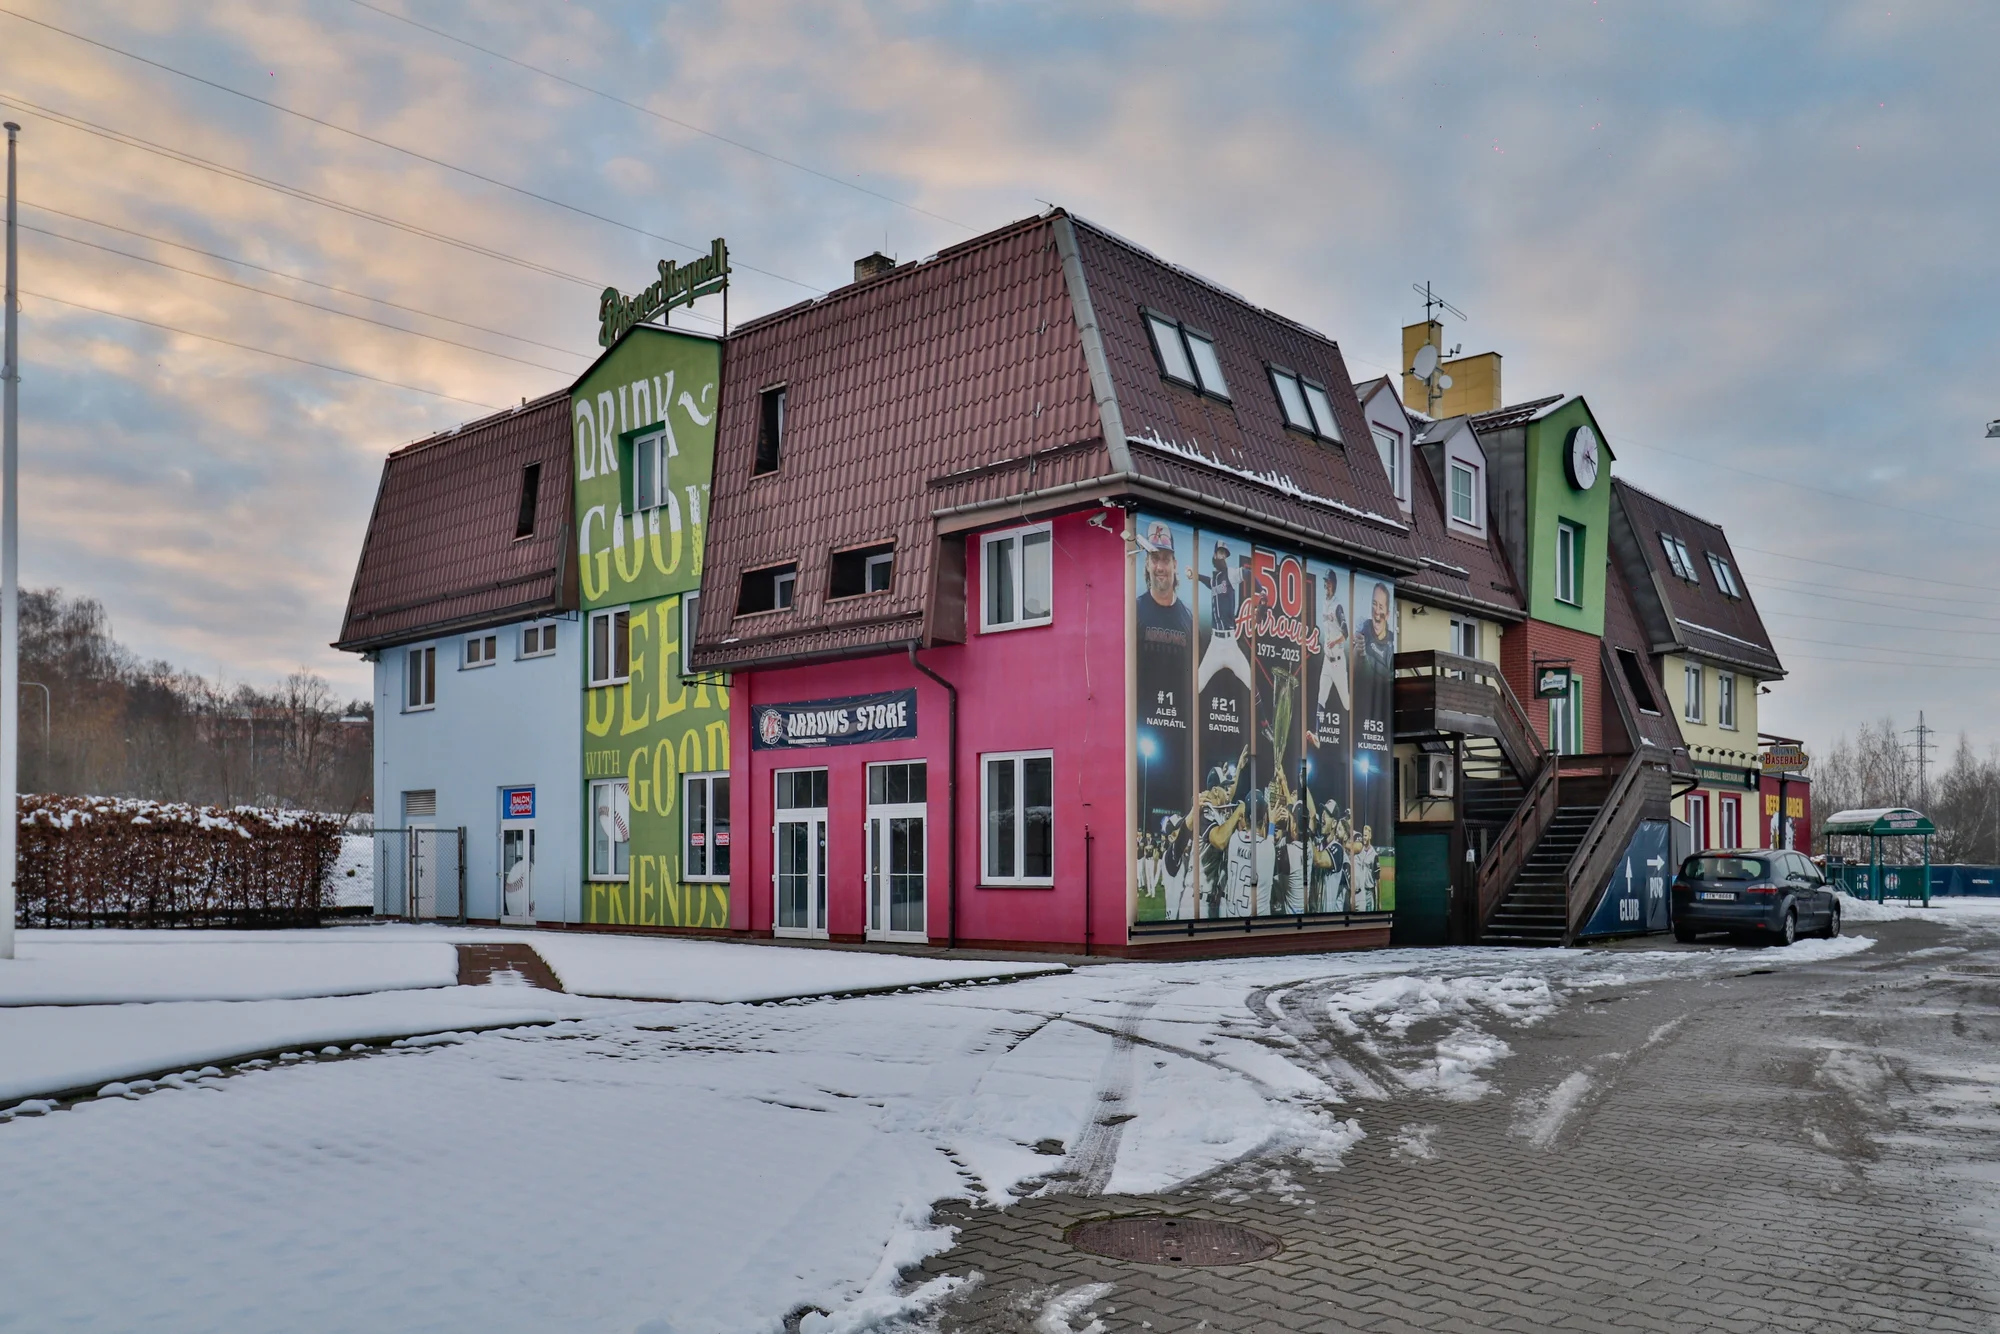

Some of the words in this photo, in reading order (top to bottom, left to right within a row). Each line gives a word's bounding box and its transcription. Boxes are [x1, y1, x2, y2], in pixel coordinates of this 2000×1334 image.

[598, 286, 661, 350] Pilsner
[658, 237, 732, 308] Urquell
[1254, 548, 1303, 619] 50
[1157, 690, 1174, 706] #1
[1211, 697, 1236, 713] #21
[787, 709, 850, 737] ARROWS
[856, 701, 907, 731] STORE
[1155, 707, 1177, 718] ALEŠ
[1209, 712, 1239, 724] ONDŘEJ
[1318, 711, 1340, 725] #13
[1146, 716, 1187, 729] NAVRÁTIL
[1208, 723, 1240, 734] SATORIA
[1364, 719, 1384, 732] #53
[1319, 726, 1340, 735] JAKUB
[585, 749, 621, 777] WITH
[1765, 754, 1803, 765] BASEBALL
[1649, 877, 1663, 899] PUB
[1620, 898, 1640, 921] CLUB
